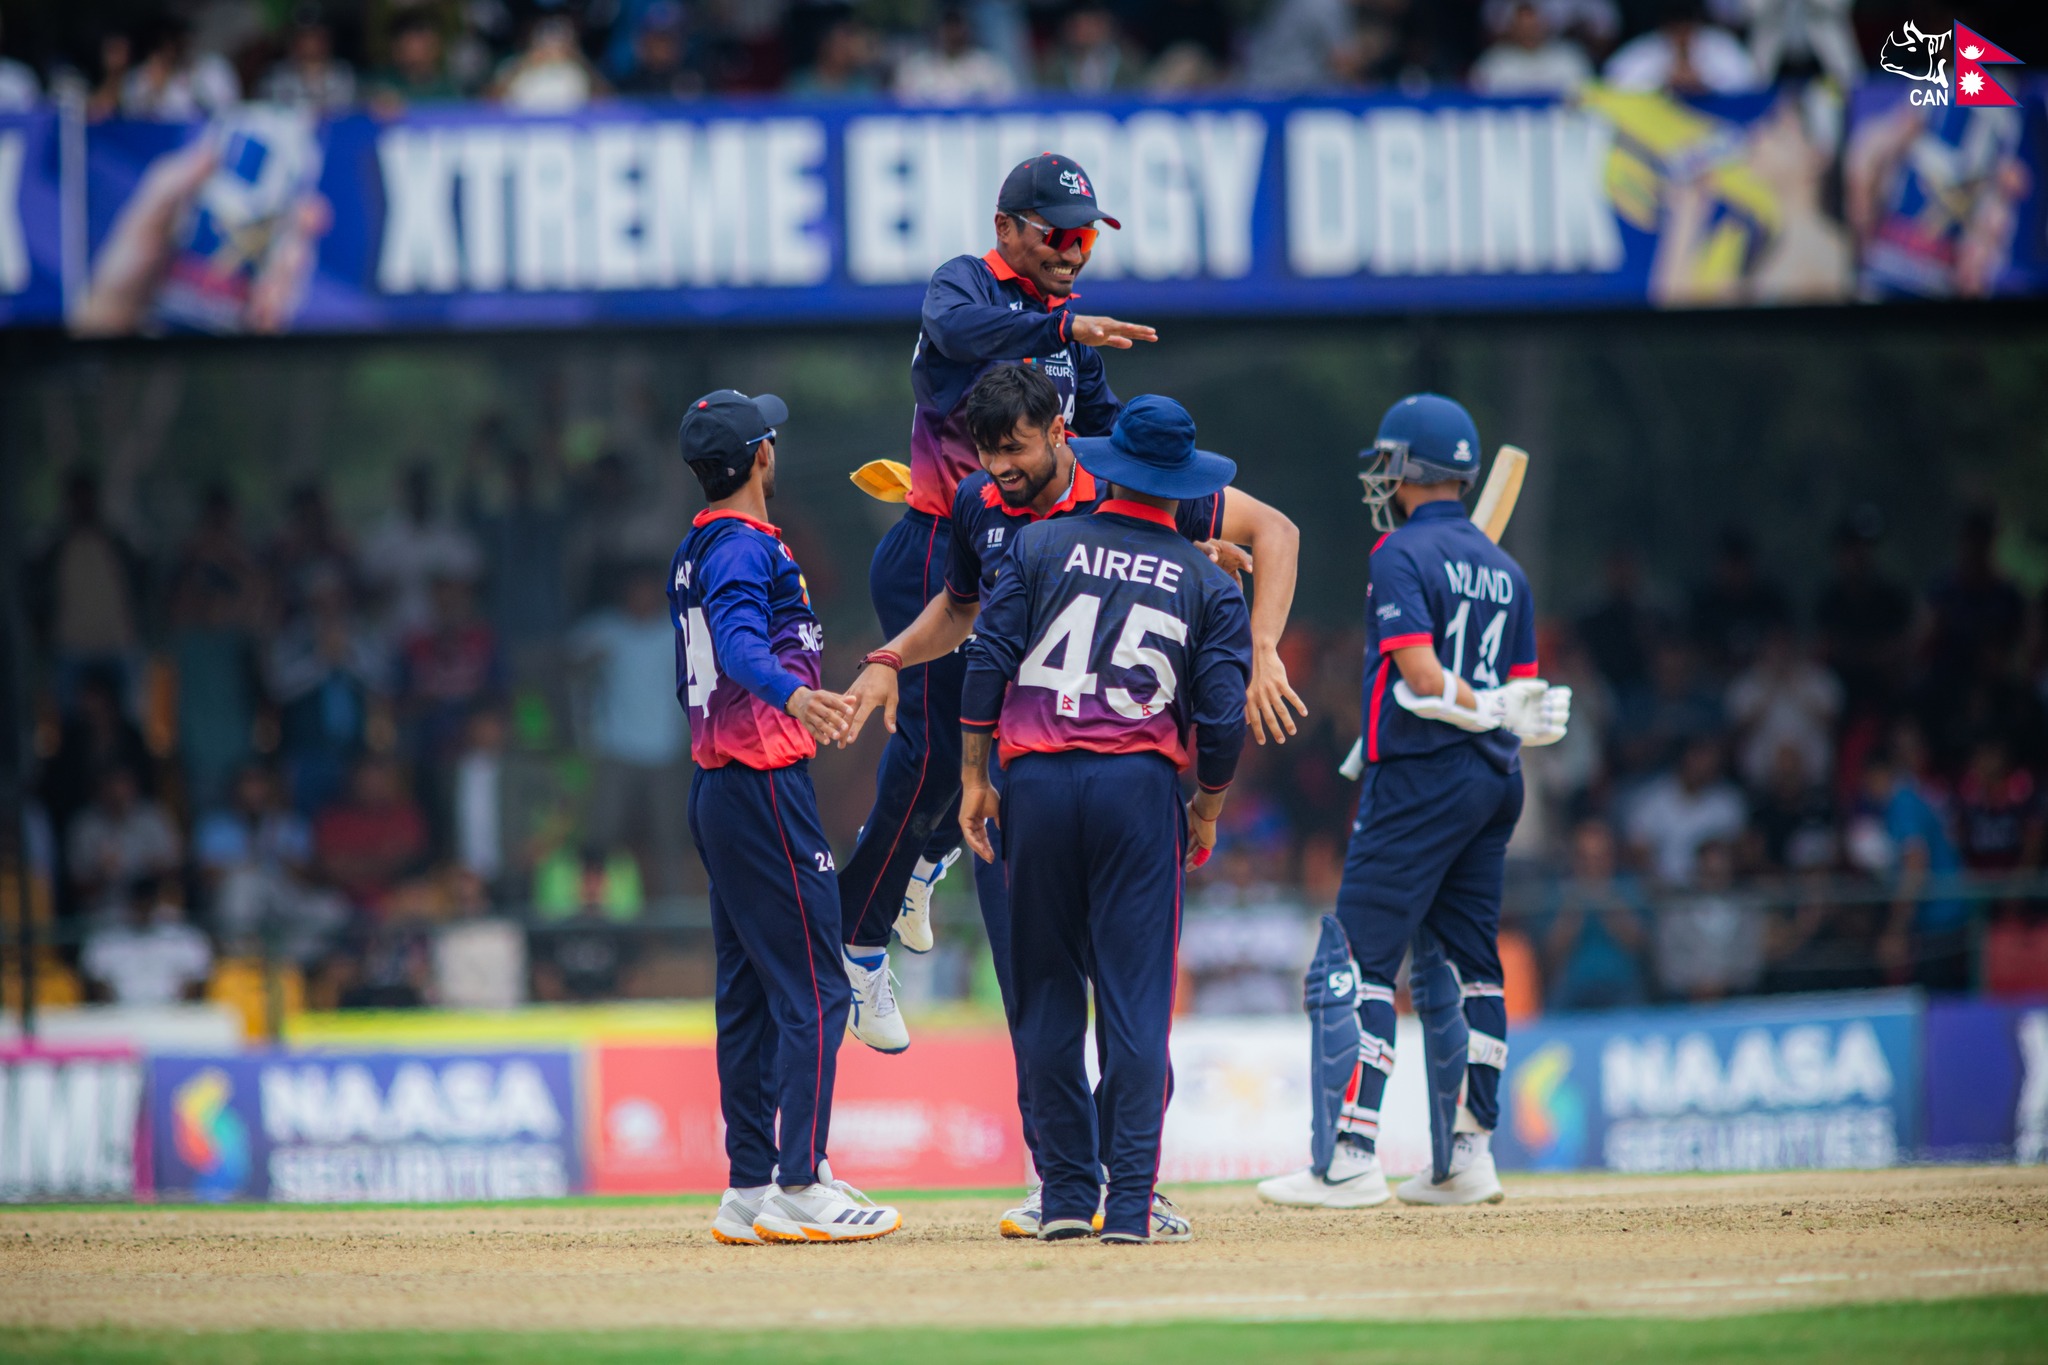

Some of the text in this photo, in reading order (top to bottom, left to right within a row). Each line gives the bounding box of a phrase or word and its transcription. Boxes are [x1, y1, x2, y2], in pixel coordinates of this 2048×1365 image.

[377, 106, 1624, 293] XTREME ENRGY DRINK
[1064, 543, 1184, 594] AIREE
[1018, 593, 1188, 720] 45
[1445, 600, 1508, 690] 14
[815, 851, 835, 872] 24
[260, 1062, 563, 1140] NAASA
[1604, 1020, 1893, 1114] NAASA
